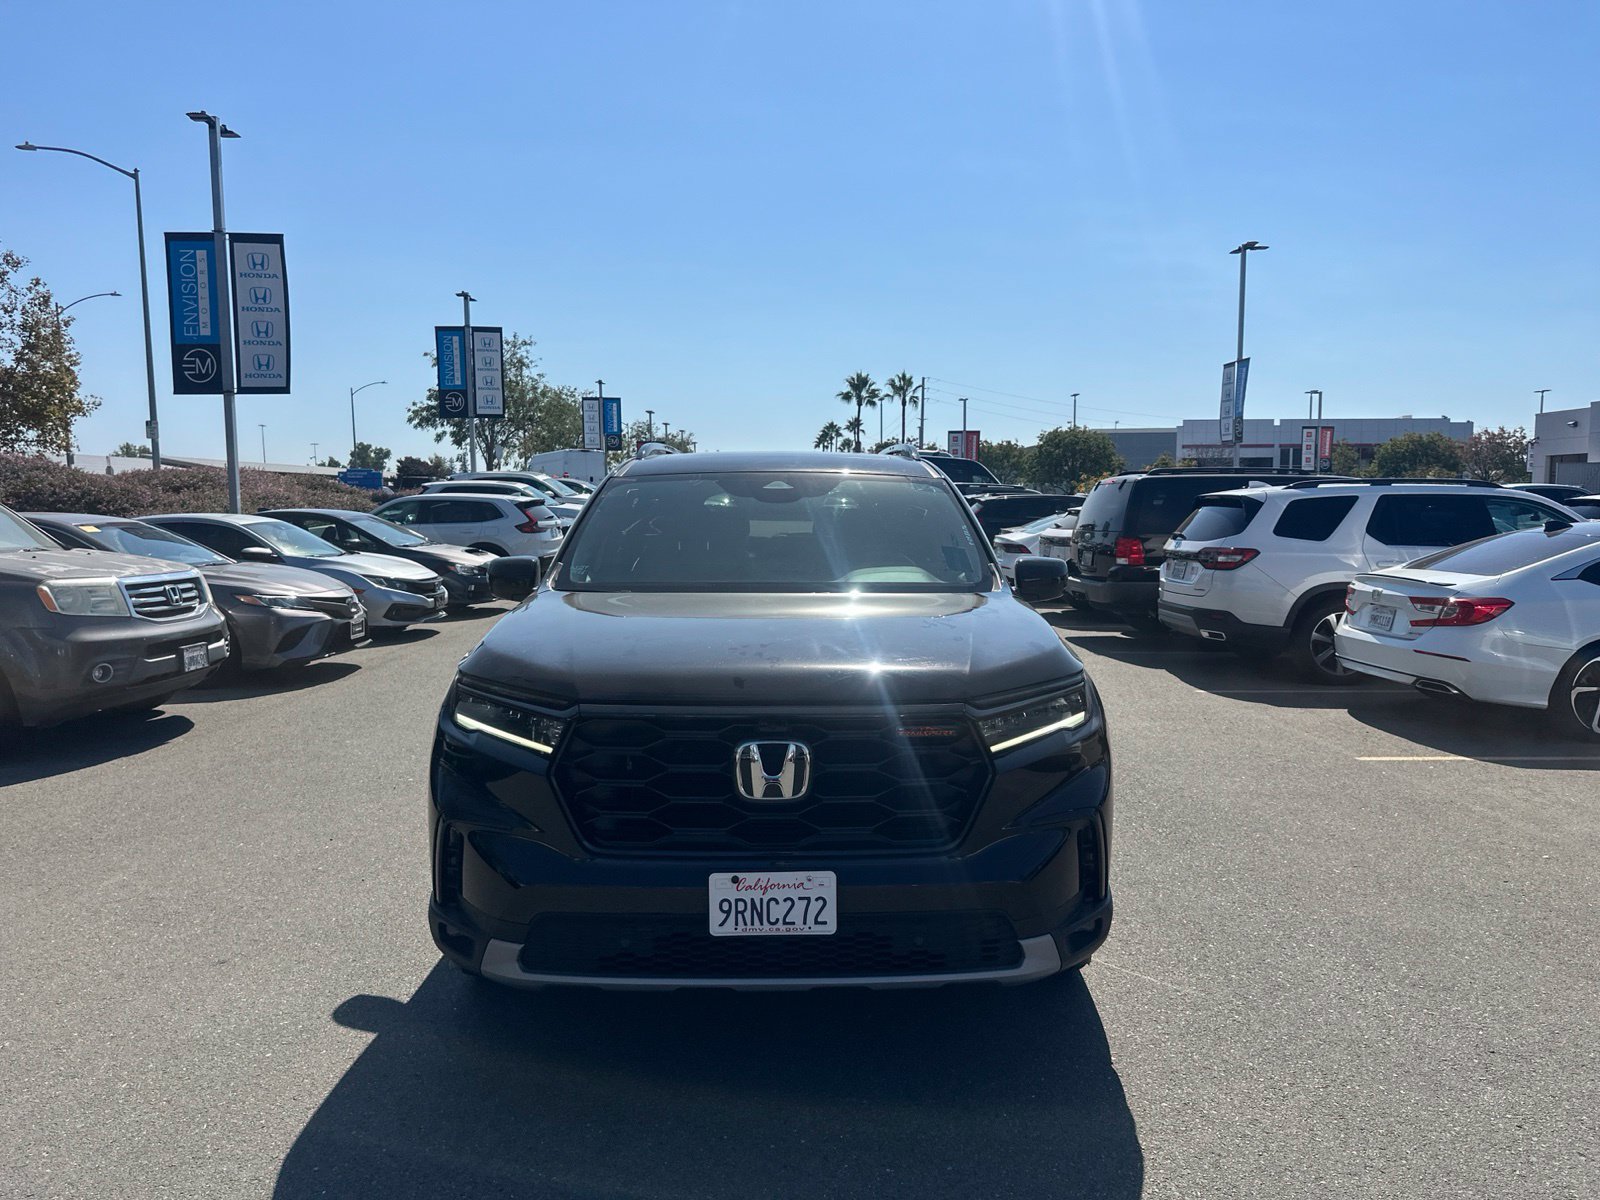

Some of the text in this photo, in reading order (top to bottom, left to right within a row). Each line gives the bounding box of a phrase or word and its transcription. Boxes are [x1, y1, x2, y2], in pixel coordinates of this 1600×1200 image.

[180, 249, 199, 337] ENVISION
[199, 257, 209, 329] MOTORS
[443, 335, 455, 386] ENVISION
[718, 896, 828, 927] 9RNC272
[735, 877, 813, 896] California
